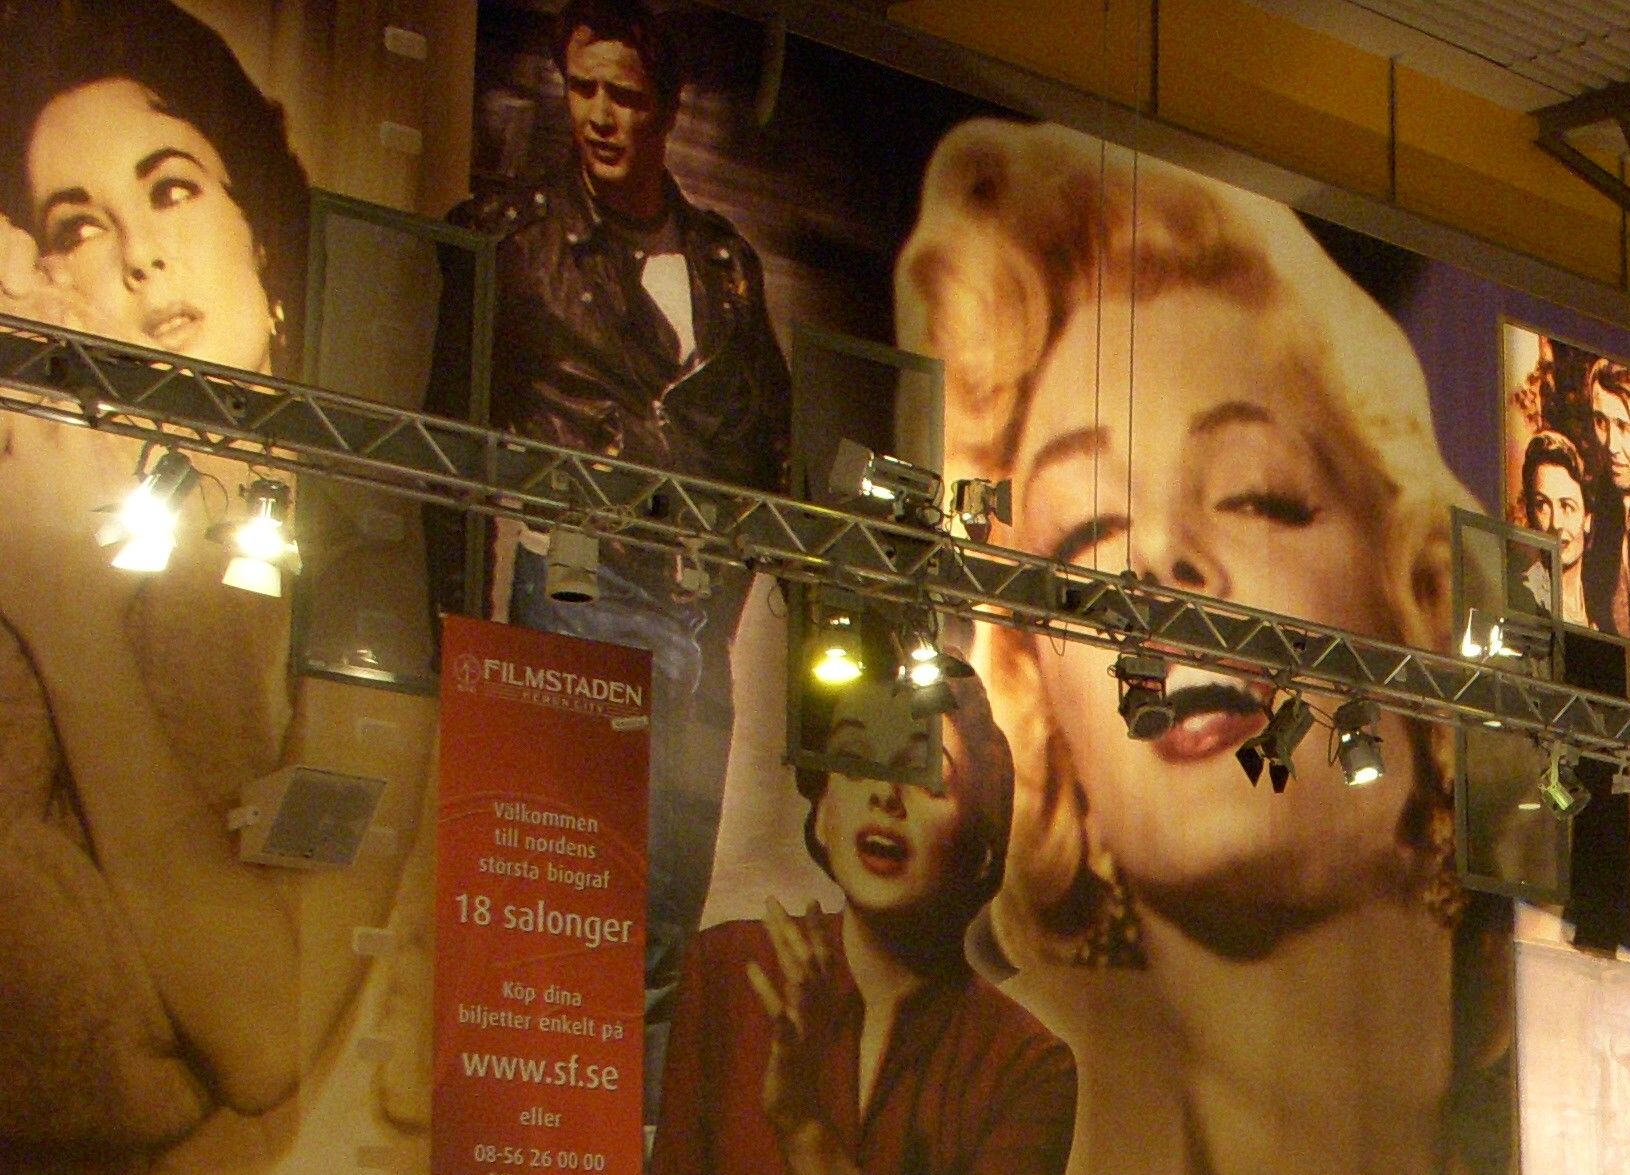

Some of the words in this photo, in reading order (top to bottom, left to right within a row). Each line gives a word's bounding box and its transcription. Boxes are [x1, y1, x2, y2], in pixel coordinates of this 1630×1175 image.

[483, 659, 642, 706] FILMSTADEN
[494, 802, 598, 834] Välkommen
[495, 829, 519, 848] till
[525, 835, 596, 860] nordens
[478, 857, 539, 880] största
[547, 865, 610, 891] biograf
[456, 893, 491, 926] 18
[503, 901, 633, 949] salonger
[503, 981, 535, 1004] Köp
[544, 985, 582, 1008] dina
[458, 1004, 531, 1030] biljetter
[539, 1014, 596, 1038] enkelt
[602, 1021, 624, 1042] på
[462, 1052, 620, 1090] www.sf.se
[519, 1107, 562, 1128] eller
[474, 1144, 524, 1166] 08-56
[529, 1150, 552, 1168] 26
[557, 1152, 578, 1170] 00
[583, 1154, 605, 1171] 00
